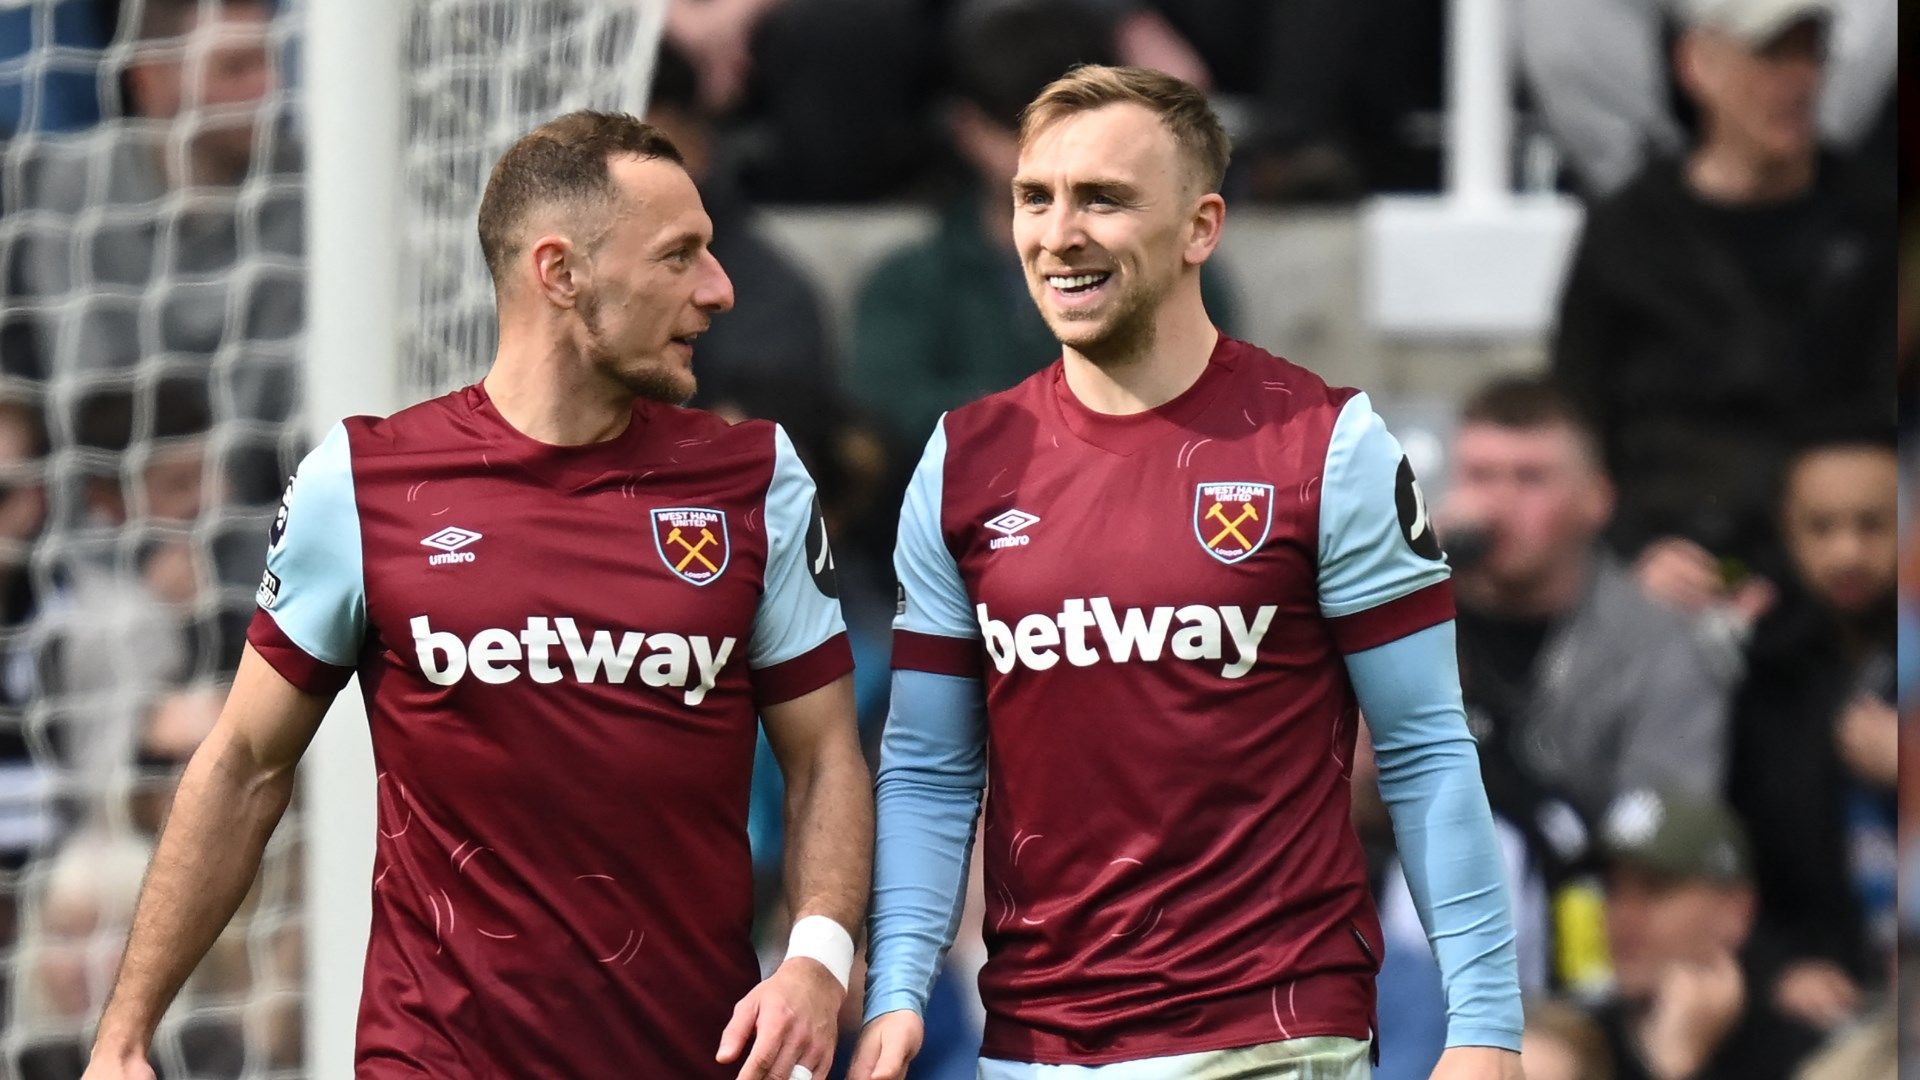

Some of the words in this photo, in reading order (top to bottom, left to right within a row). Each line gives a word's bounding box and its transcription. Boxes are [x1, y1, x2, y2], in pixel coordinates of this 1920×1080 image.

[1204, 487, 1235, 496] WEST
[1236, 486, 1265, 497] HAM
[1216, 493, 1252, 502] UNITED
[658, 511, 689, 521] WEST
[690, 511, 719, 522] HAM
[671, 519, 707, 527] UNITED
[990, 534, 1030, 550] umbro
[428, 550, 476, 566] umbro
[976, 597, 1278, 679] betway
[410, 615, 737, 706] betway
